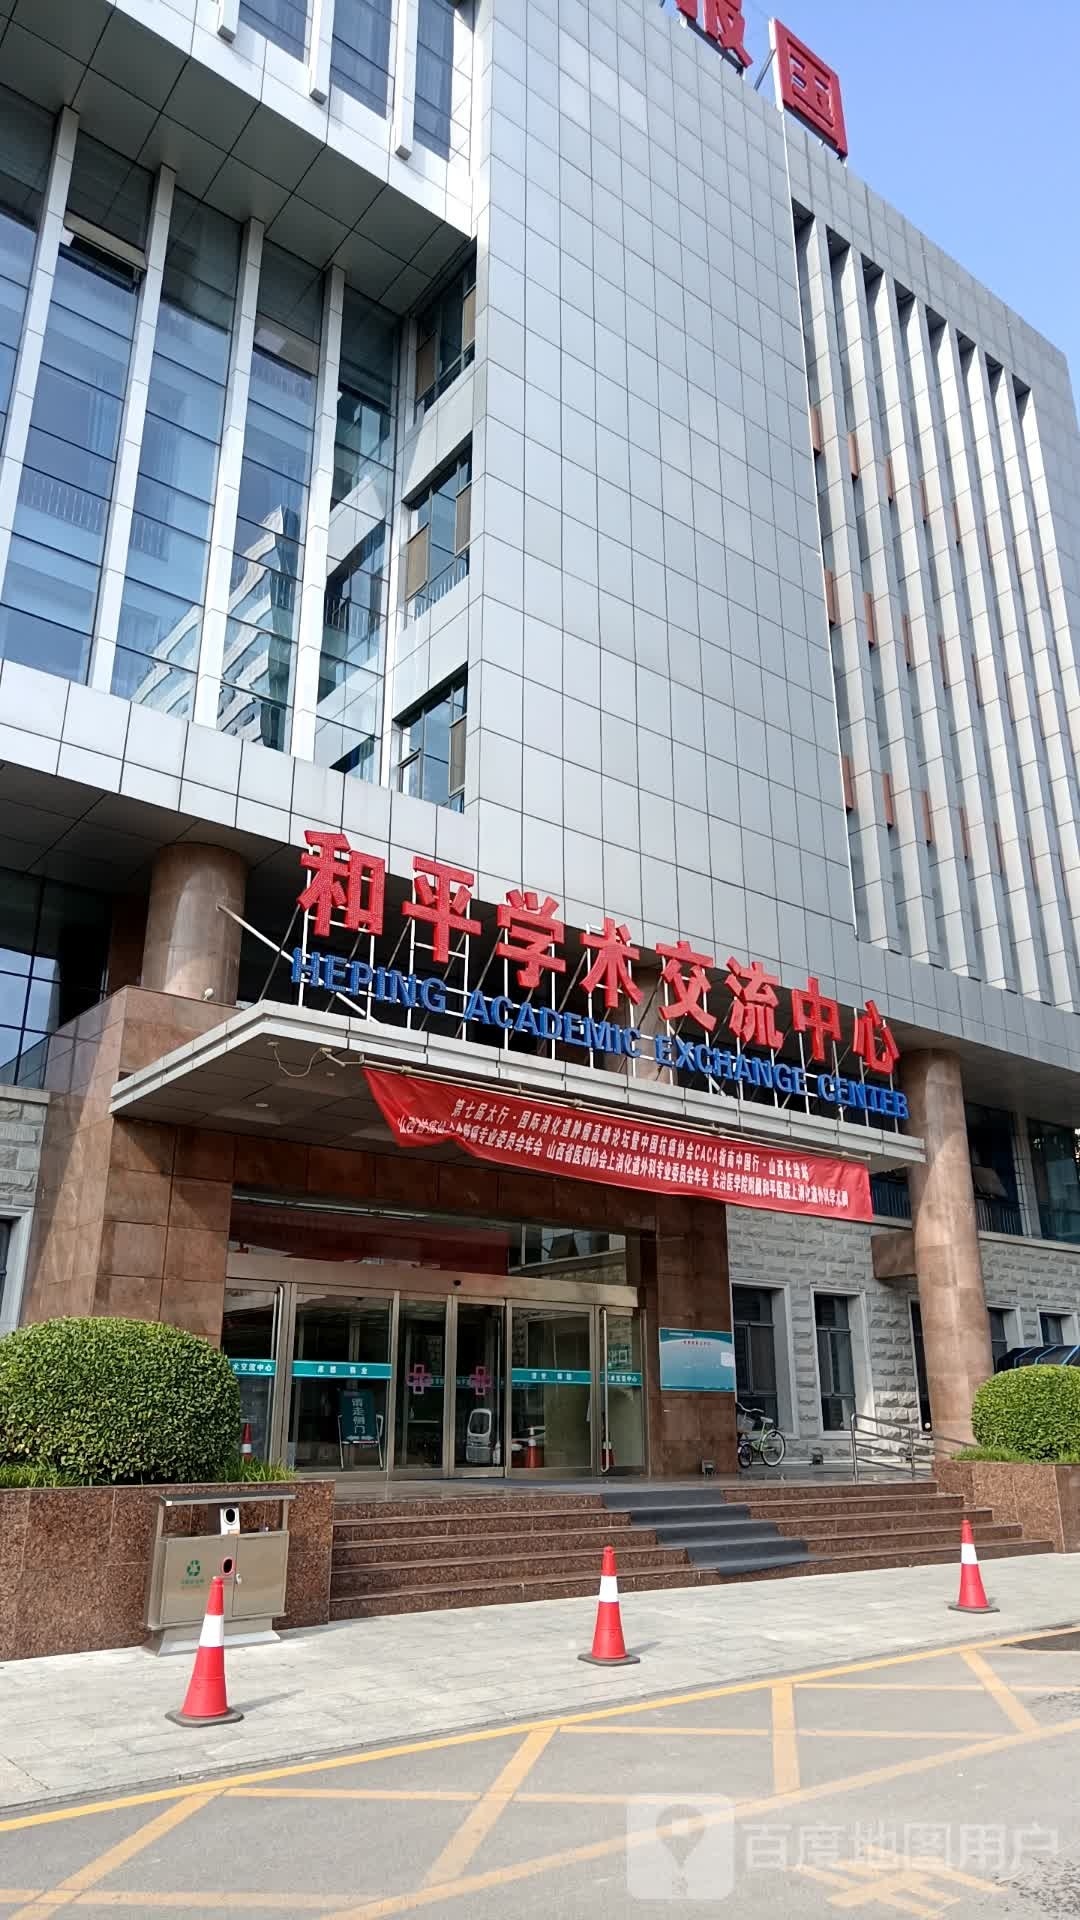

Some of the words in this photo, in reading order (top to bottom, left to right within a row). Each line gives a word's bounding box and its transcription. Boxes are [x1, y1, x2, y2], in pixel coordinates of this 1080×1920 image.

[291, 947, 447, 1014] HEPING
[465, 990, 641, 1058] ACADEMIC
[655, 1034, 808, 1096] EXCHANGE
[818, 1073, 910, 1120] CENTER
[297, 830, 900, 1075] 和平学术交流中心
